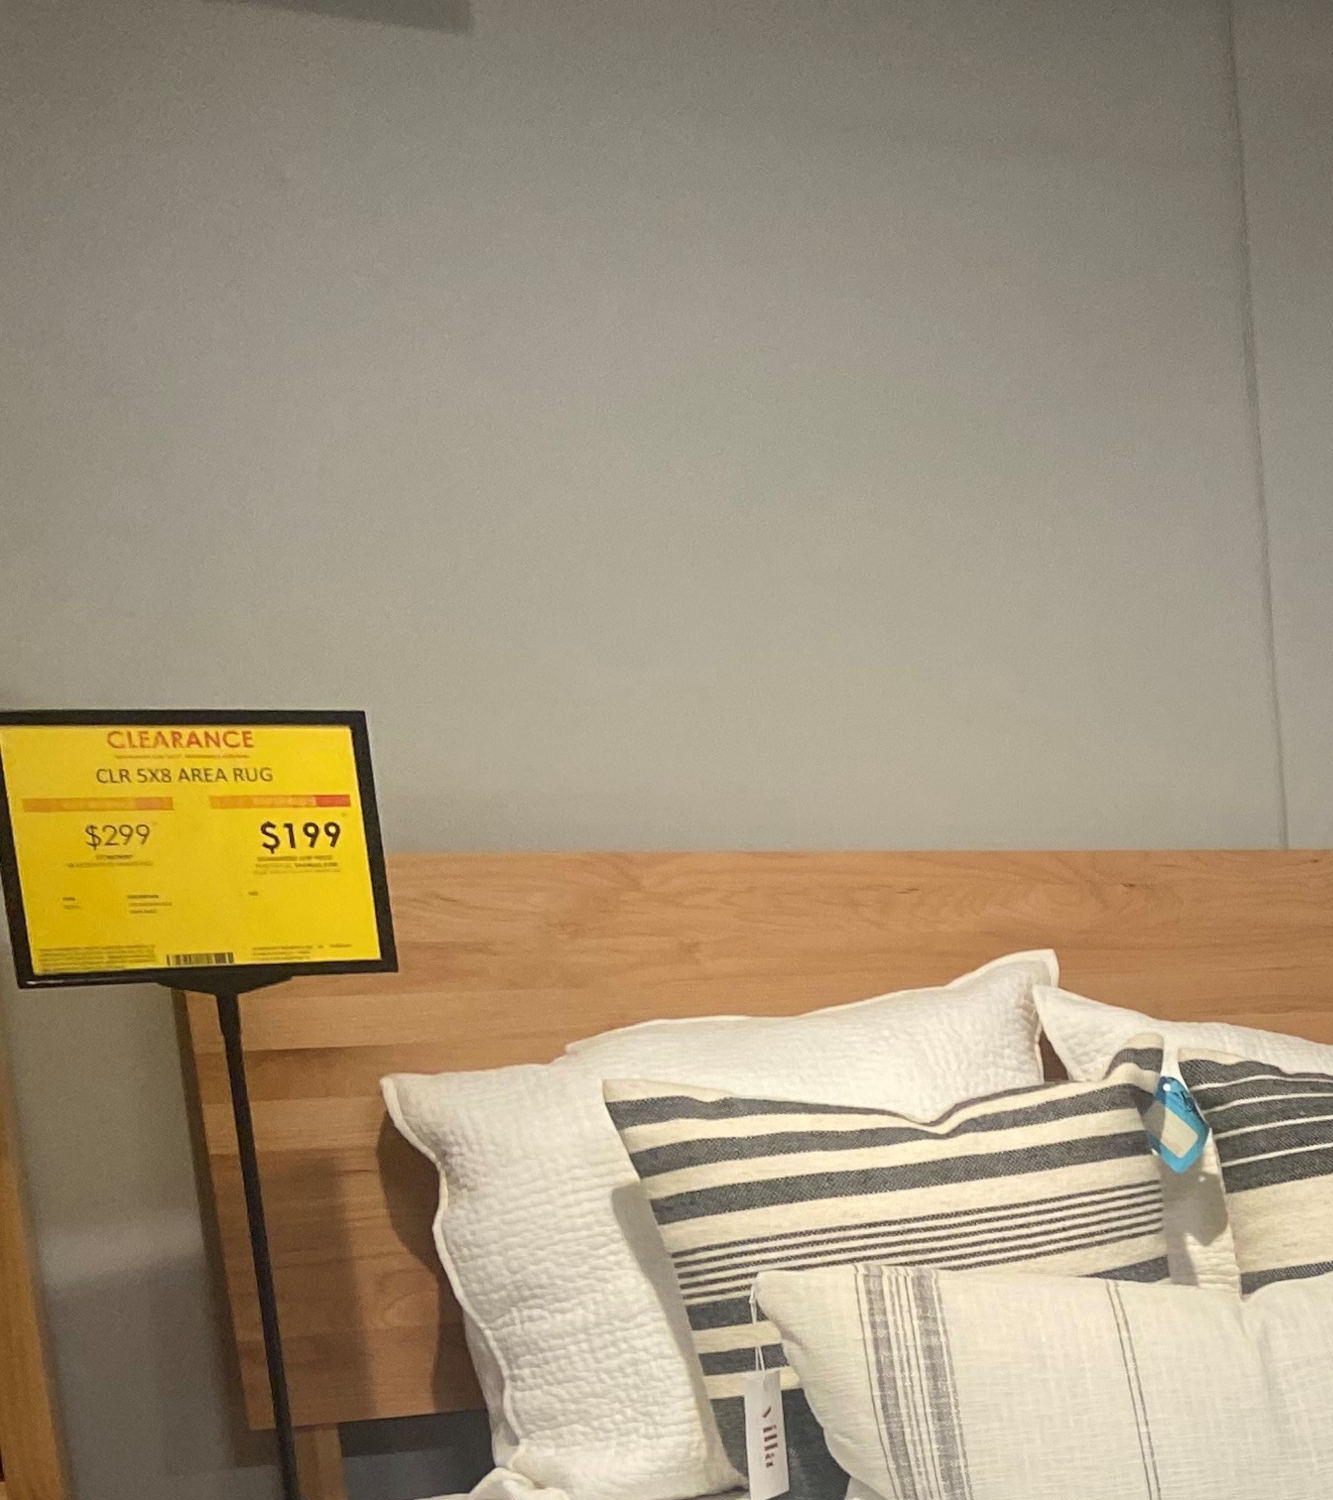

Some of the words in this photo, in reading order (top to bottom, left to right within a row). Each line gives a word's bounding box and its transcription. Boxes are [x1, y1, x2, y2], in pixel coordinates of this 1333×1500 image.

[107, 731, 255, 749] CLEARANCE
[96, 768, 131, 783] CLR
[178, 768, 228, 782] AREA
[233, 767, 273, 782] RUG
[85, 824, 150, 850] $299
[260, 821, 341, 854] $199
